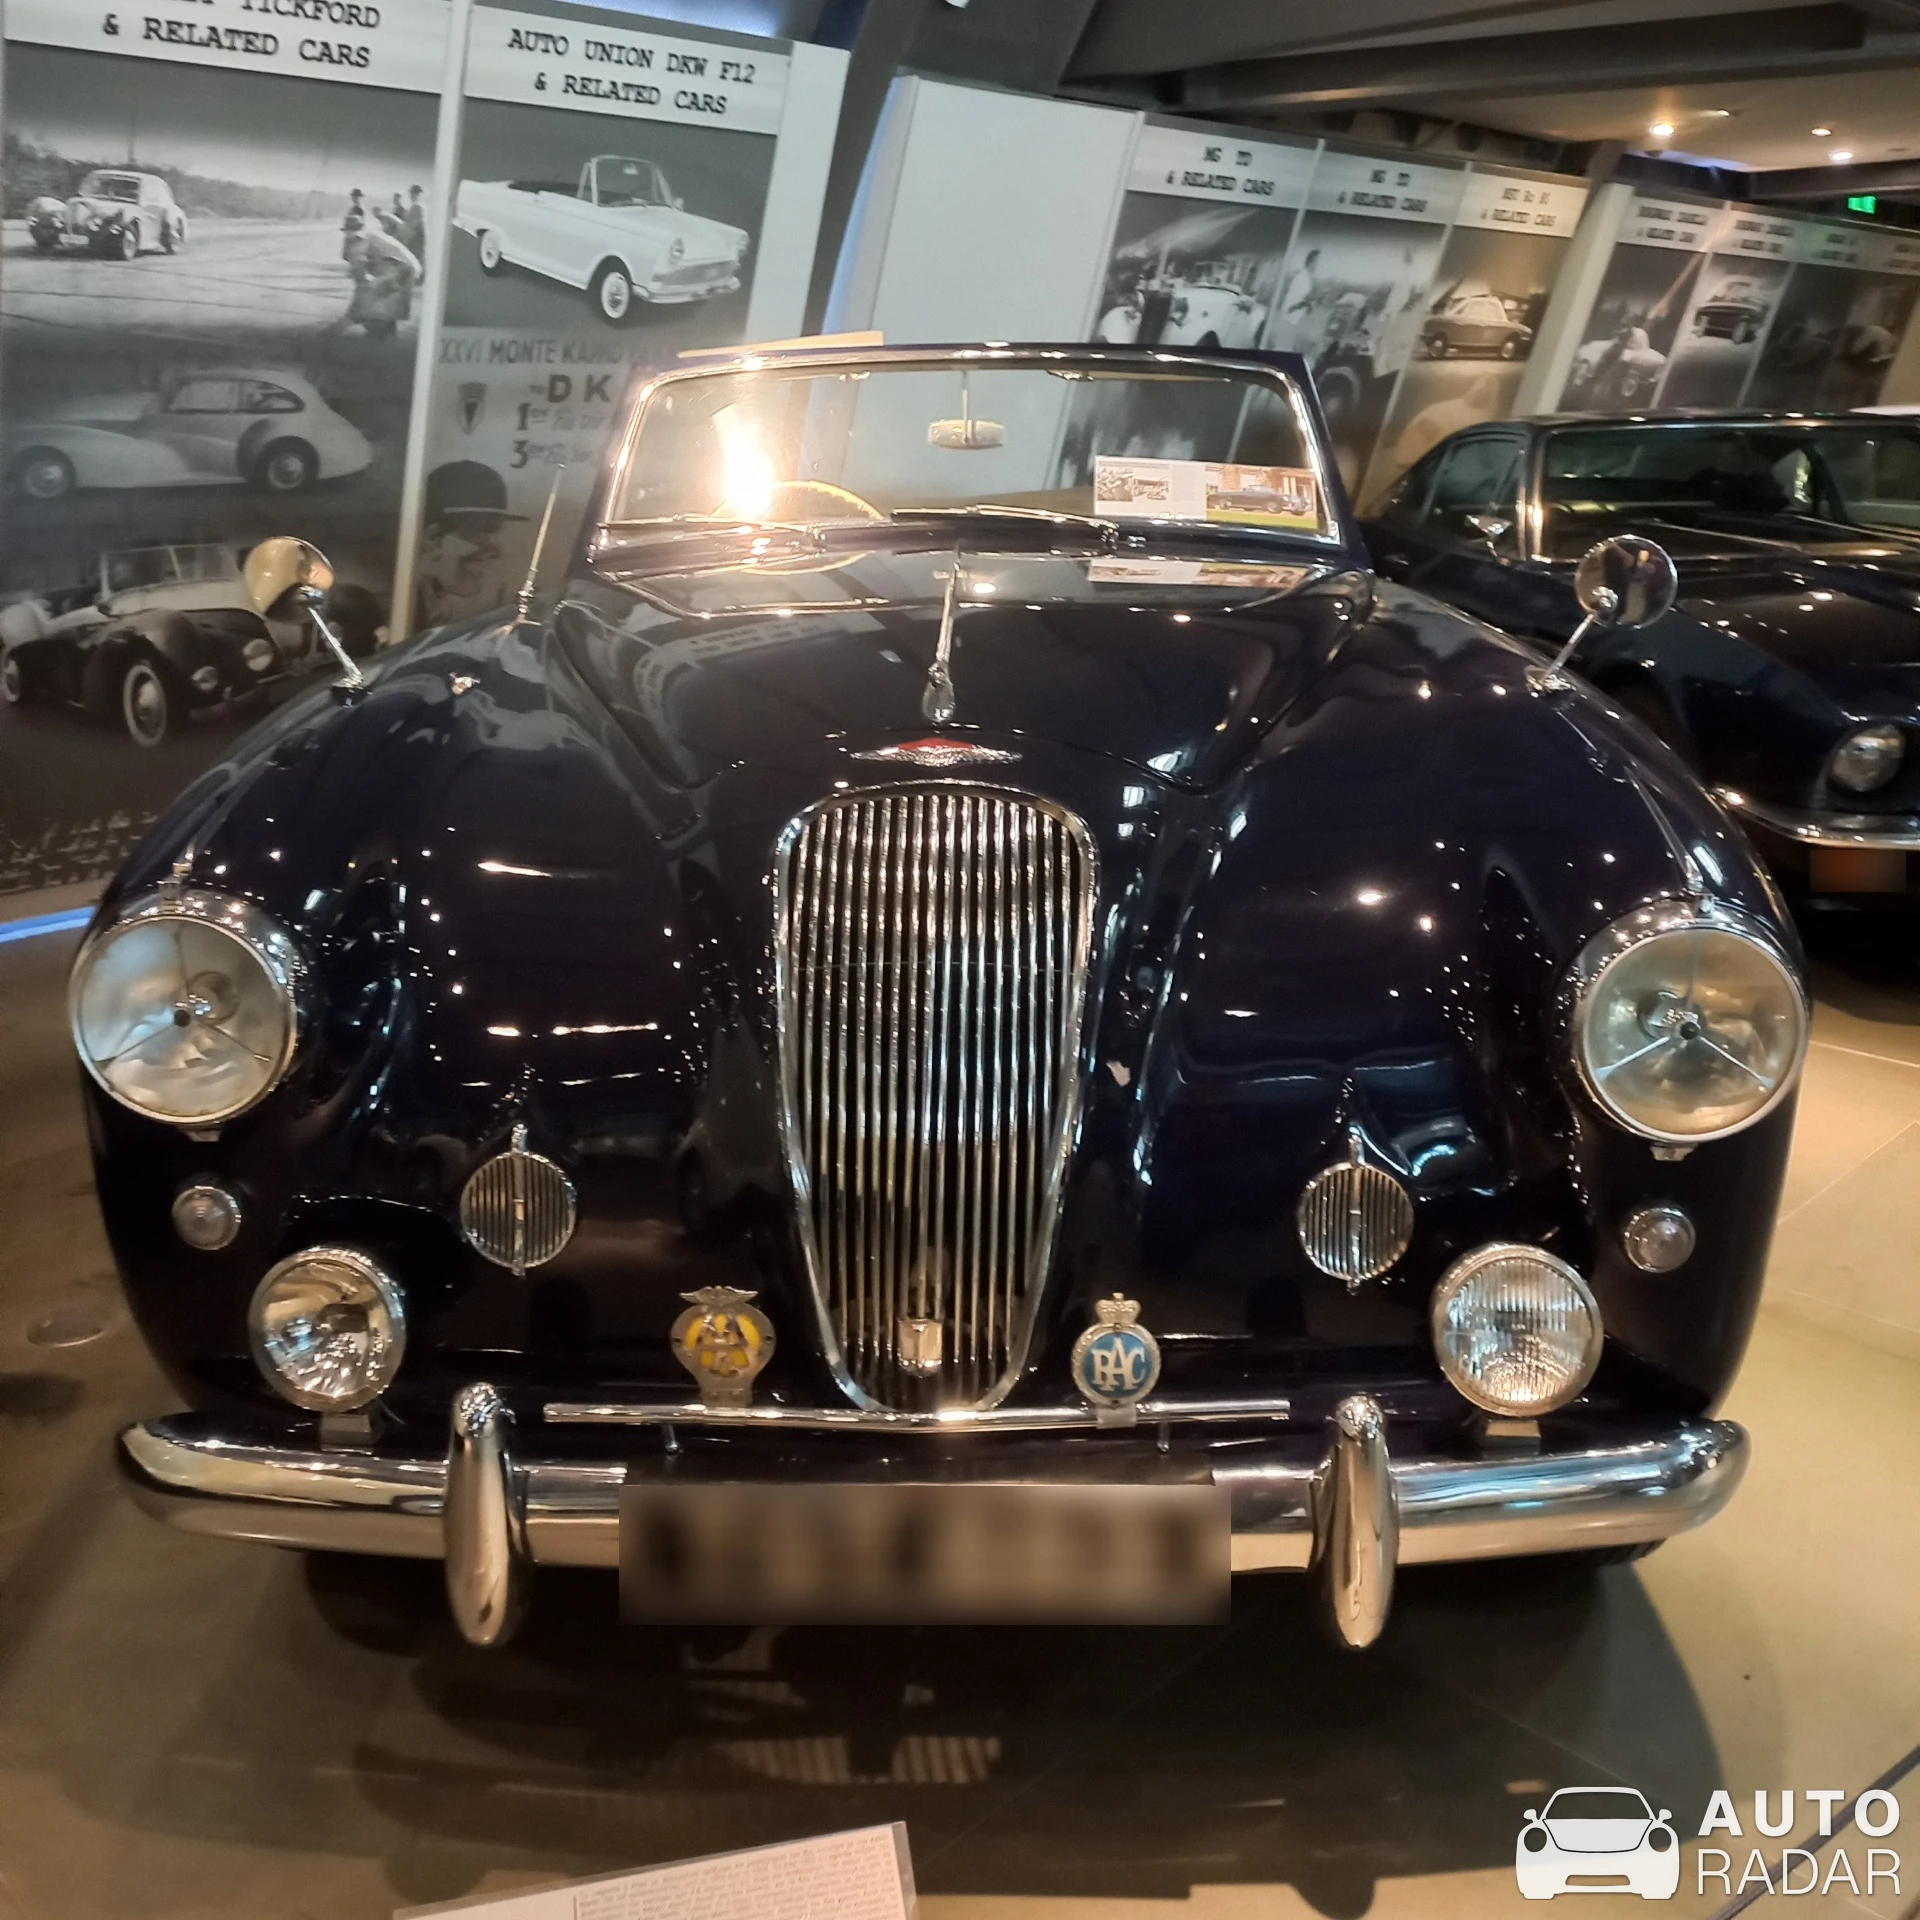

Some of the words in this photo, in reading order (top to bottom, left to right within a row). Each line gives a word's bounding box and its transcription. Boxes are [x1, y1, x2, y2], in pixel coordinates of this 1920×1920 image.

[102, 14, 120, 36] &
[142, 17, 280, 56] RELATED
[299, 38, 371, 68] CARS
[507, 28, 569, 56] AUTO
[584, 40, 655, 70] UNION
[666, 52, 708, 77] DKW
[719, 60, 757, 84] F12
[534, 72, 548, 92] &
[561, 74, 661, 107] RELATED
[674, 91, 728, 115] CARS
[487, 338, 558, 364] MONTE
[1090, 1336, 1146, 1392] RAC
